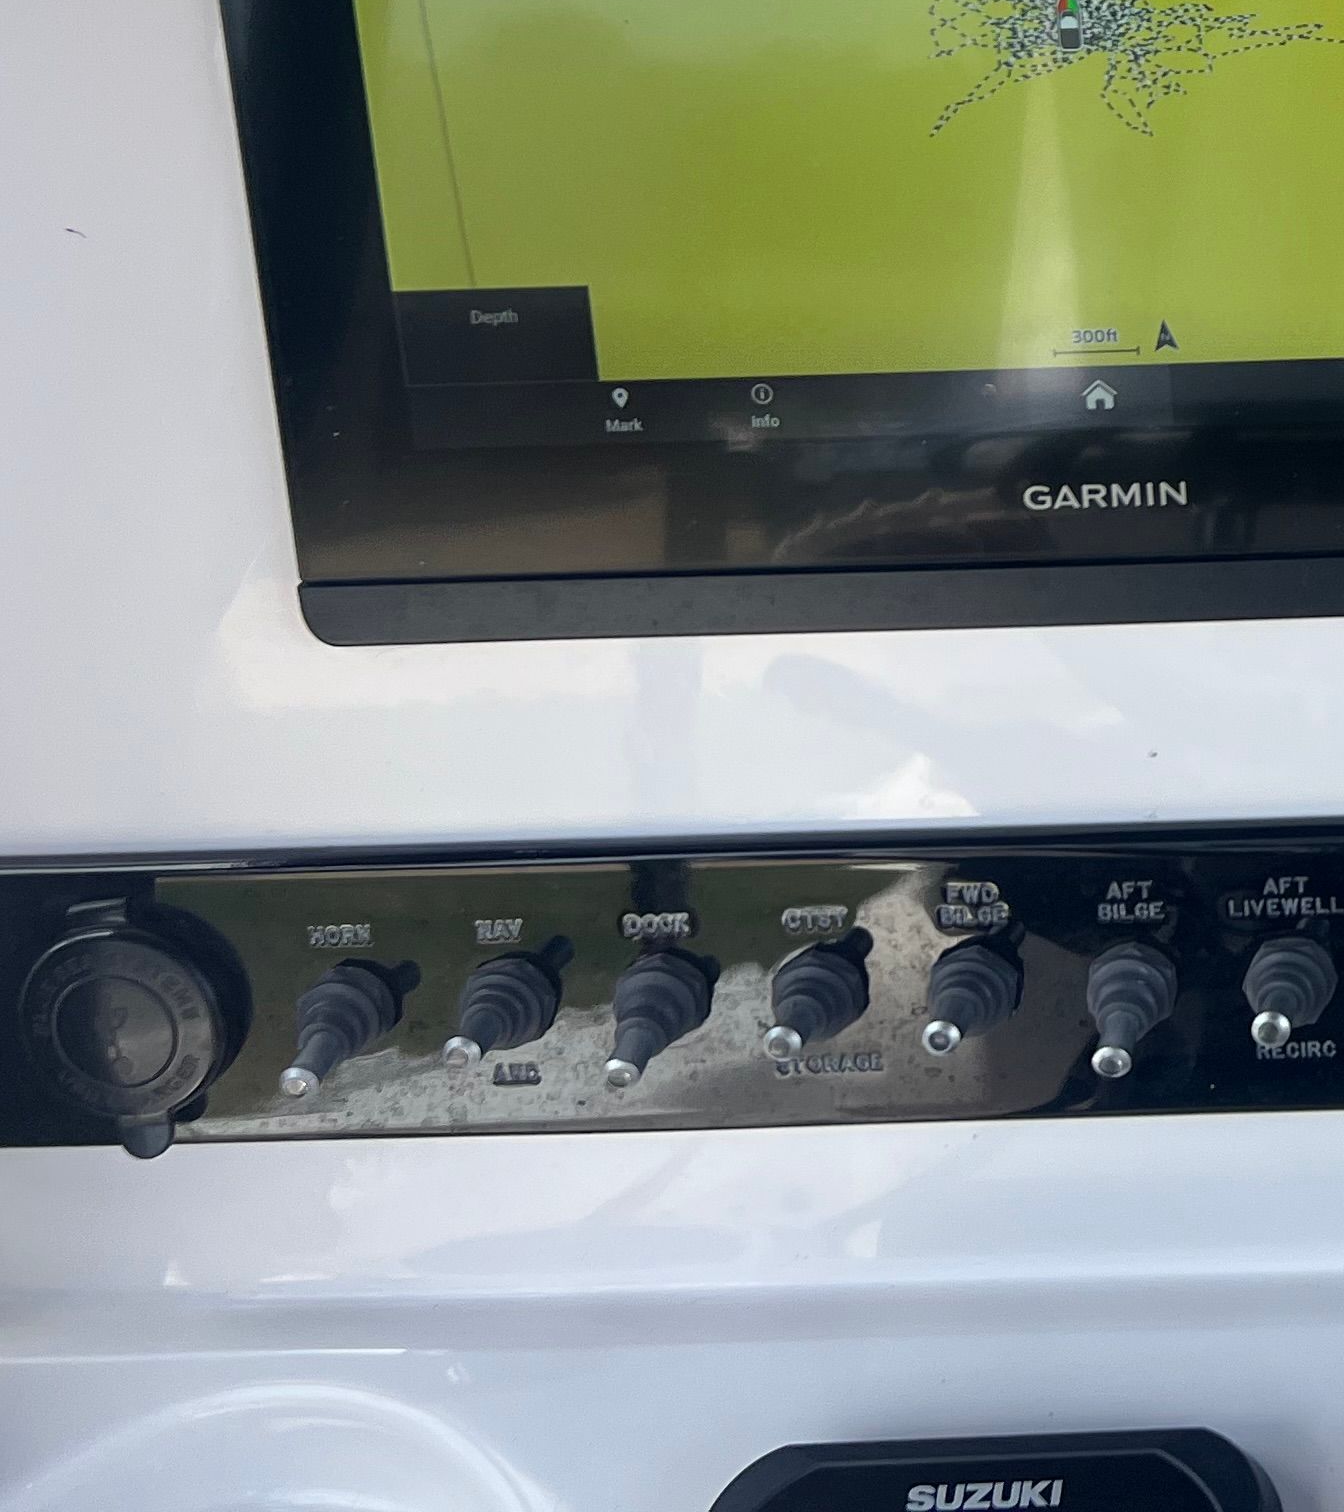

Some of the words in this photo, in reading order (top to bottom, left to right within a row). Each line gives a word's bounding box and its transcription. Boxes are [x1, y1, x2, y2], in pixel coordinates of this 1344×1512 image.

[469, 307, 519, 328] Depth
[1071, 327, 1119, 345] 300ft
[605, 417, 643, 433] Mark
[750, 413, 781, 429] Info
[1022, 480, 1189, 510] GARMIN
[943, 881, 1001, 905] FWD
[1105, 880, 1153, 901] AFT
[1262, 876, 1309, 896] AFT
[1096, 901, 1166, 923] BILGE
[1255, 1039, 1338, 1059] RECIRC
[906, 1479, 1063, 1511] SUZUKI
